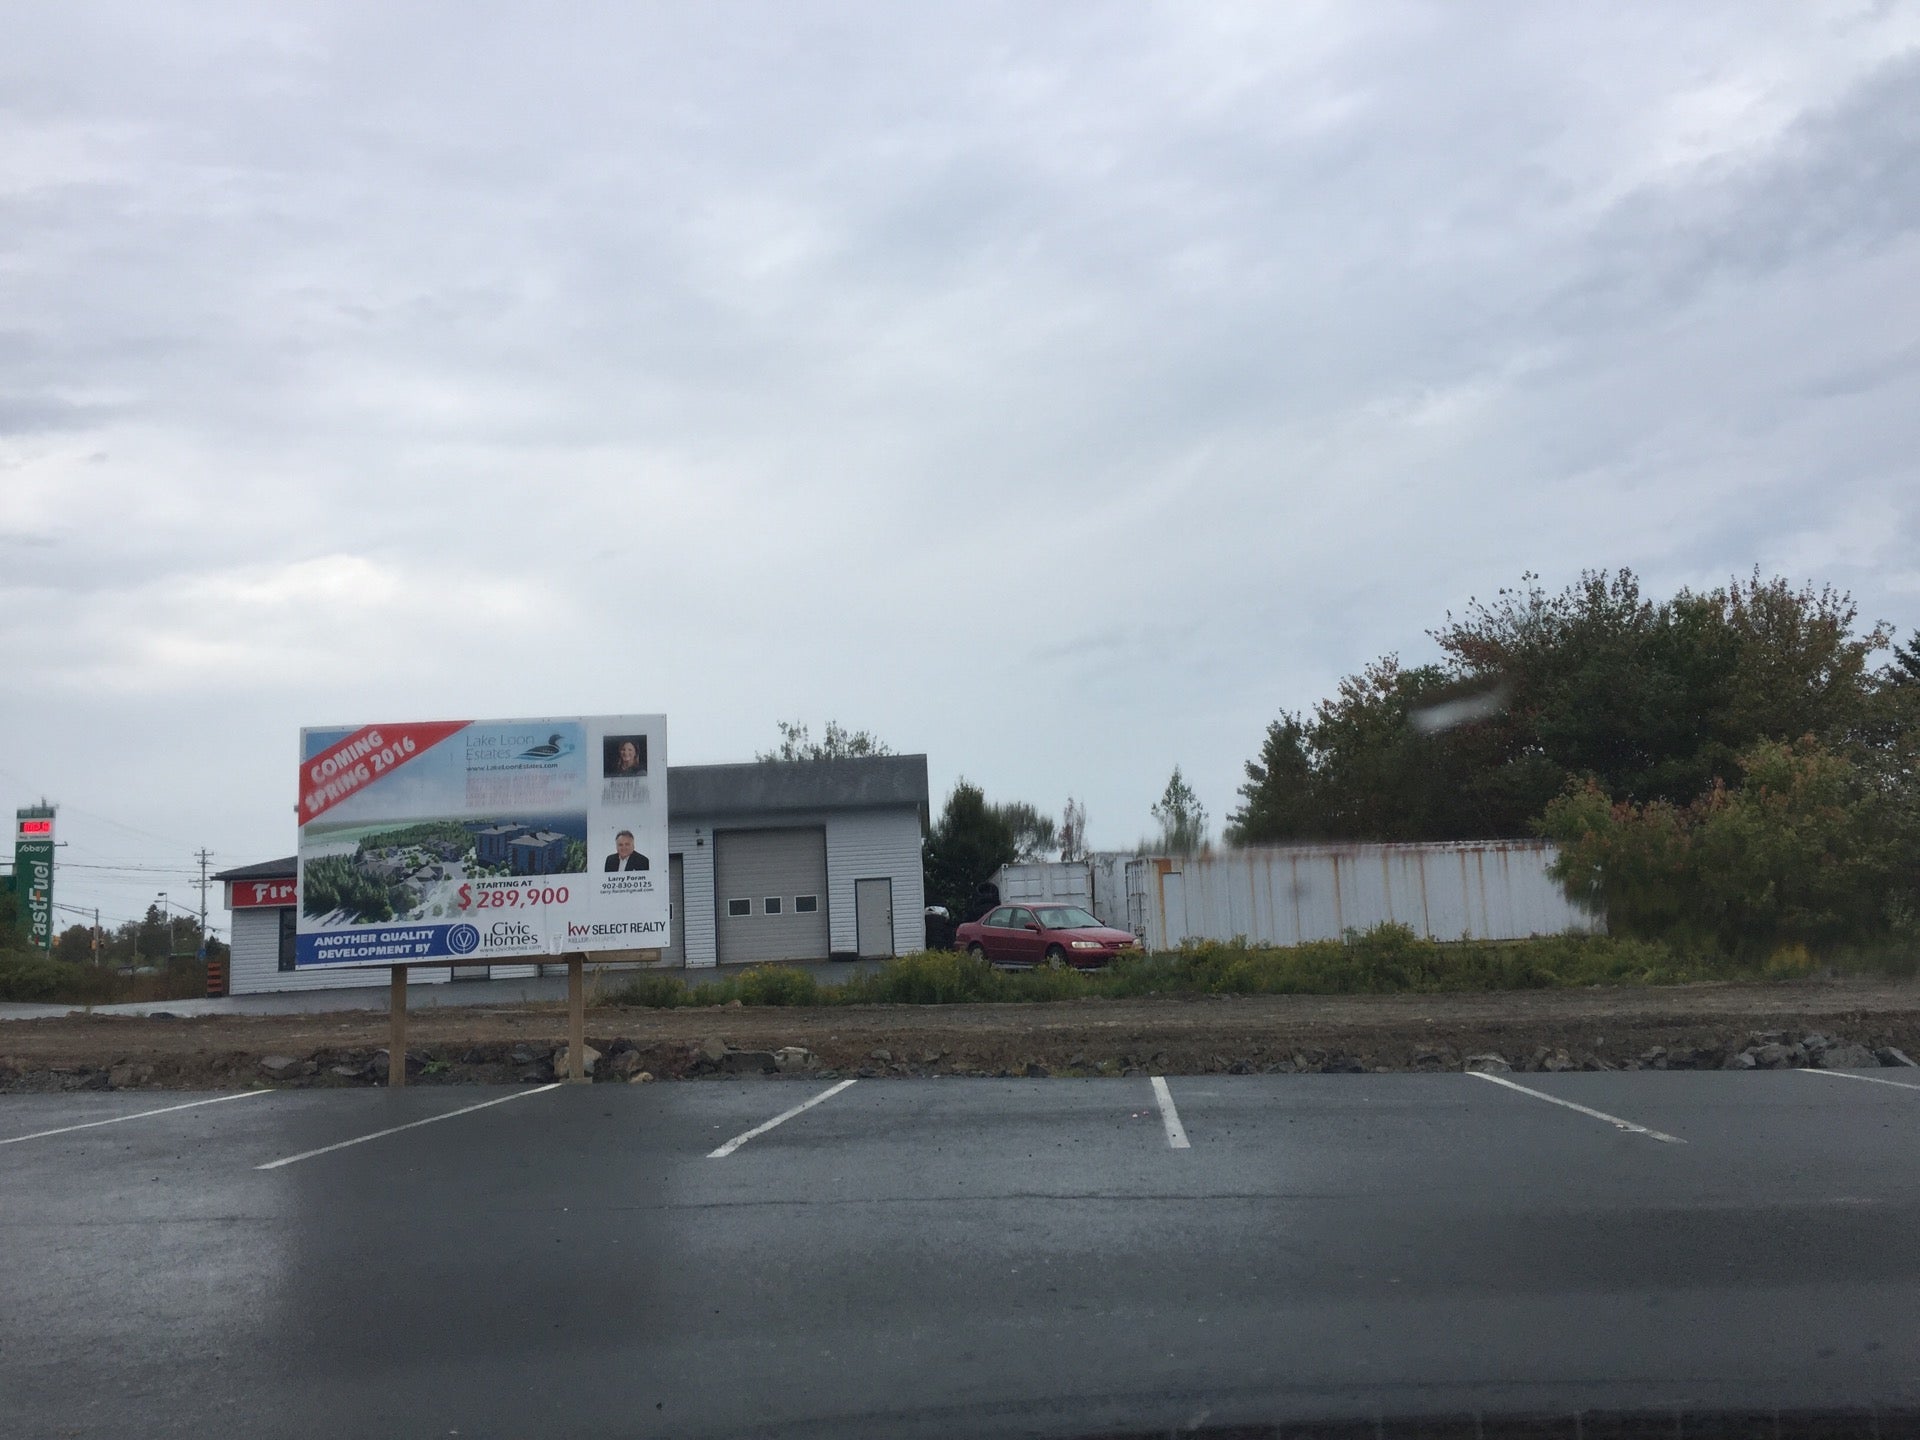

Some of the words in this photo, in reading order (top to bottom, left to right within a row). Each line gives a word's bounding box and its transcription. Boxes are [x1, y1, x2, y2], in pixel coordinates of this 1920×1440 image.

[466, 735, 497, 747] Lake
[500, 734, 535, 746] Loon
[311, 730, 384, 785] COMING
[466, 747, 511, 761] Estates
[305, 763, 370, 813] SPRING
[370, 736, 416, 772] 2016
[18, 844, 49, 853] Sobeys
[476, 881, 519, 889] STARTING
[602, 881, 652, 889] 902-830-0125
[492, 921, 530, 936] Civic
[568, 921, 590, 936] kw
[592, 923, 628, 935] SELECT
[630, 921, 666, 933] REALTY
[314, 933, 377, 947] ANOTHER
[380, 930, 435, 942] QUALITY
[484, 933, 538, 947] Homes
[317, 944, 412, 960] DEVELOPMENT
[415, 943, 431, 954] BY
